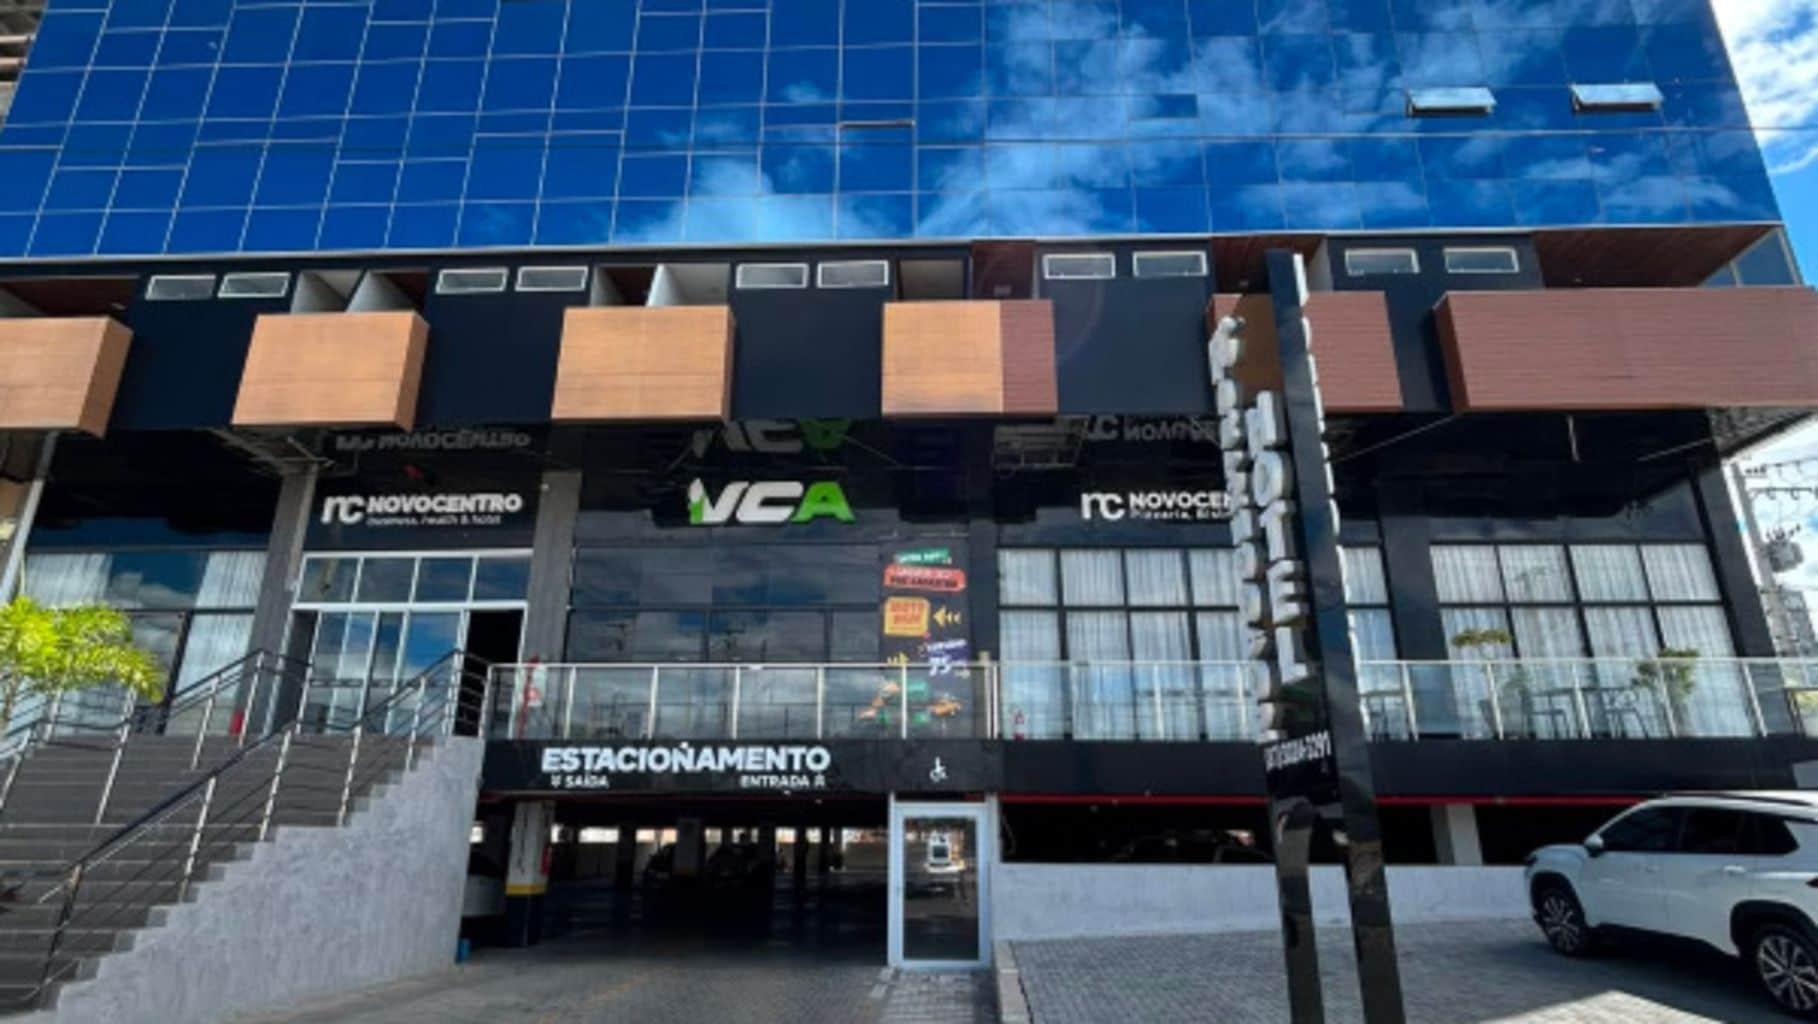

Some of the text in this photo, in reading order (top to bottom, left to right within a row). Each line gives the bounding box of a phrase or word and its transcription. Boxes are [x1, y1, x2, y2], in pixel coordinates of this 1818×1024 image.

[366, 493, 522, 513] NOVOCENTRO
[688, 477, 856, 525] VCA
[1245, 390, 1308, 684] HOTEL
[541, 747, 831, 772] ESTACIONAMENTO
[740, 774, 810, 788] ENTRADA
